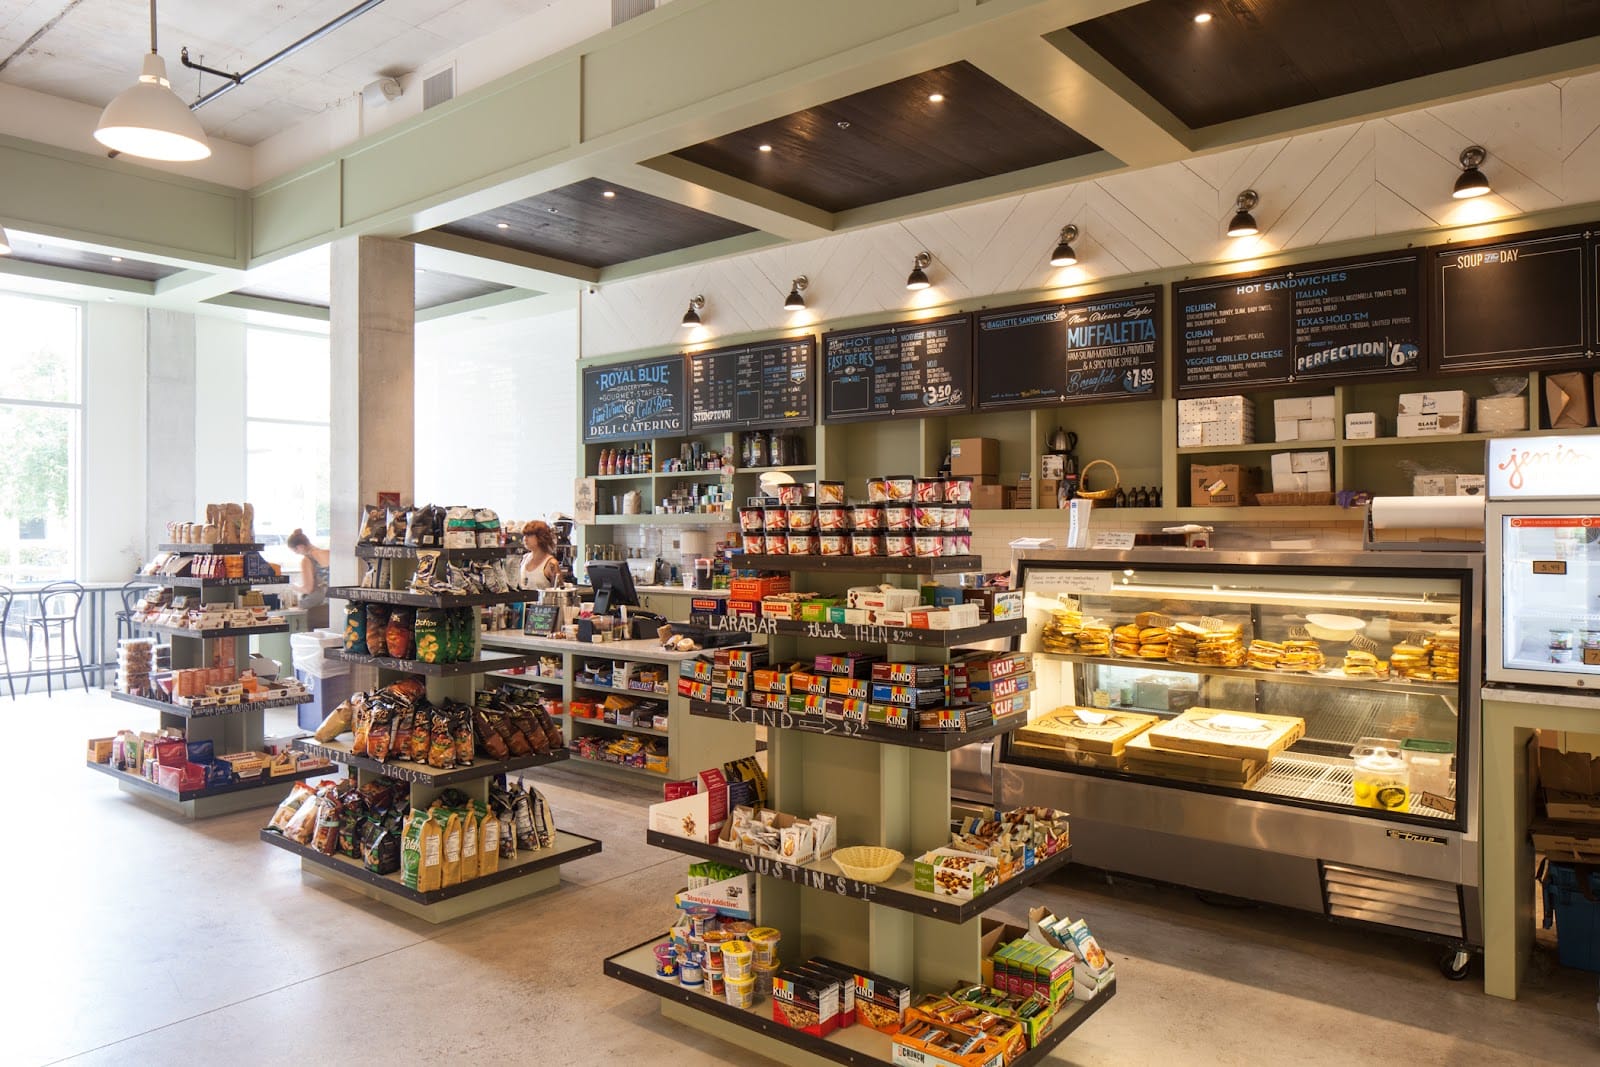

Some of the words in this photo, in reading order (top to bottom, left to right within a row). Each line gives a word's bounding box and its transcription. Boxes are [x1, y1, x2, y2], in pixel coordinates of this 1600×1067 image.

[1457, 254, 1482, 269] SOUP
[1500, 249, 1520, 264] DAY
[1236, 284, 1262, 295] HOT
[1264, 272, 1347, 291] SANDWICHES
[1295, 288, 1328, 300] ITALIAN
[1088, 301, 1135, 313] TRADITIONAL
[1185, 302, 1217, 314] REUBEN
[986, 317, 1018, 329] BAGUETTE
[1019, 312, 1058, 325] SANDWICHES
[1296, 316, 1325, 327] TEXAS
[1326, 313, 1352, 324] HOLD
[1067, 318, 1157, 349] MUFFALETTA
[1185, 329, 1214, 340] CUBAN
[845, 336, 871, 347] HOT
[827, 355, 843, 373] EAST
[844, 353, 858, 365] SIDE
[858, 352, 874, 368] PIES
[1185, 355, 1214, 366] VEGGIE
[1216, 352, 1249, 364] GRILLED
[1250, 349, 1284, 360] CHEESE
[1297, 341, 1385, 371] PERFECTION
[600, 369, 636, 392] ROYAL
[638, 364, 669, 385] BLUE
[1126, 368, 1153, 388] $7.99
[602, 391, 634, 403] GOURMET
[636, 388, 665, 399] STAPLES
[590, 424, 617, 436] DELI
[622, 418, 680, 434] CATERING
[374, 547, 402, 559] STACY'S
[808, 622, 846, 641] think
[853, 624, 887, 645] THIN
[729, 659, 747, 669] KIND
[831, 664, 850, 674] KIND
[996, 660, 1015, 674] CLIF
[694, 672, 711, 682] KIND
[726, 678, 744, 688] KIND
[890, 671, 911, 682] KIND
[769, 682, 787, 692] KIND
[807, 684, 827, 695] KIND
[998, 679, 1017, 694] CLIF
[690, 691, 707, 702] KIND
[726, 695, 743, 705] KIND
[890, 694, 912, 704] KIND
[766, 700, 784, 710] KIND
[804, 705, 824, 716] KIND
[994, 699, 1013, 714] CLIF
[728, 704, 794, 729] KIND
[886, 716, 908, 728] KIND
[938, 719, 961, 729] KIND
[381, 765, 417, 784] STACY'S
[746, 853, 848, 897] JUSTIN'S
[772, 988, 794, 1002] KIND
[853, 986, 875, 999] KIND
[902, 1047, 926, 1065] CRUNCH
